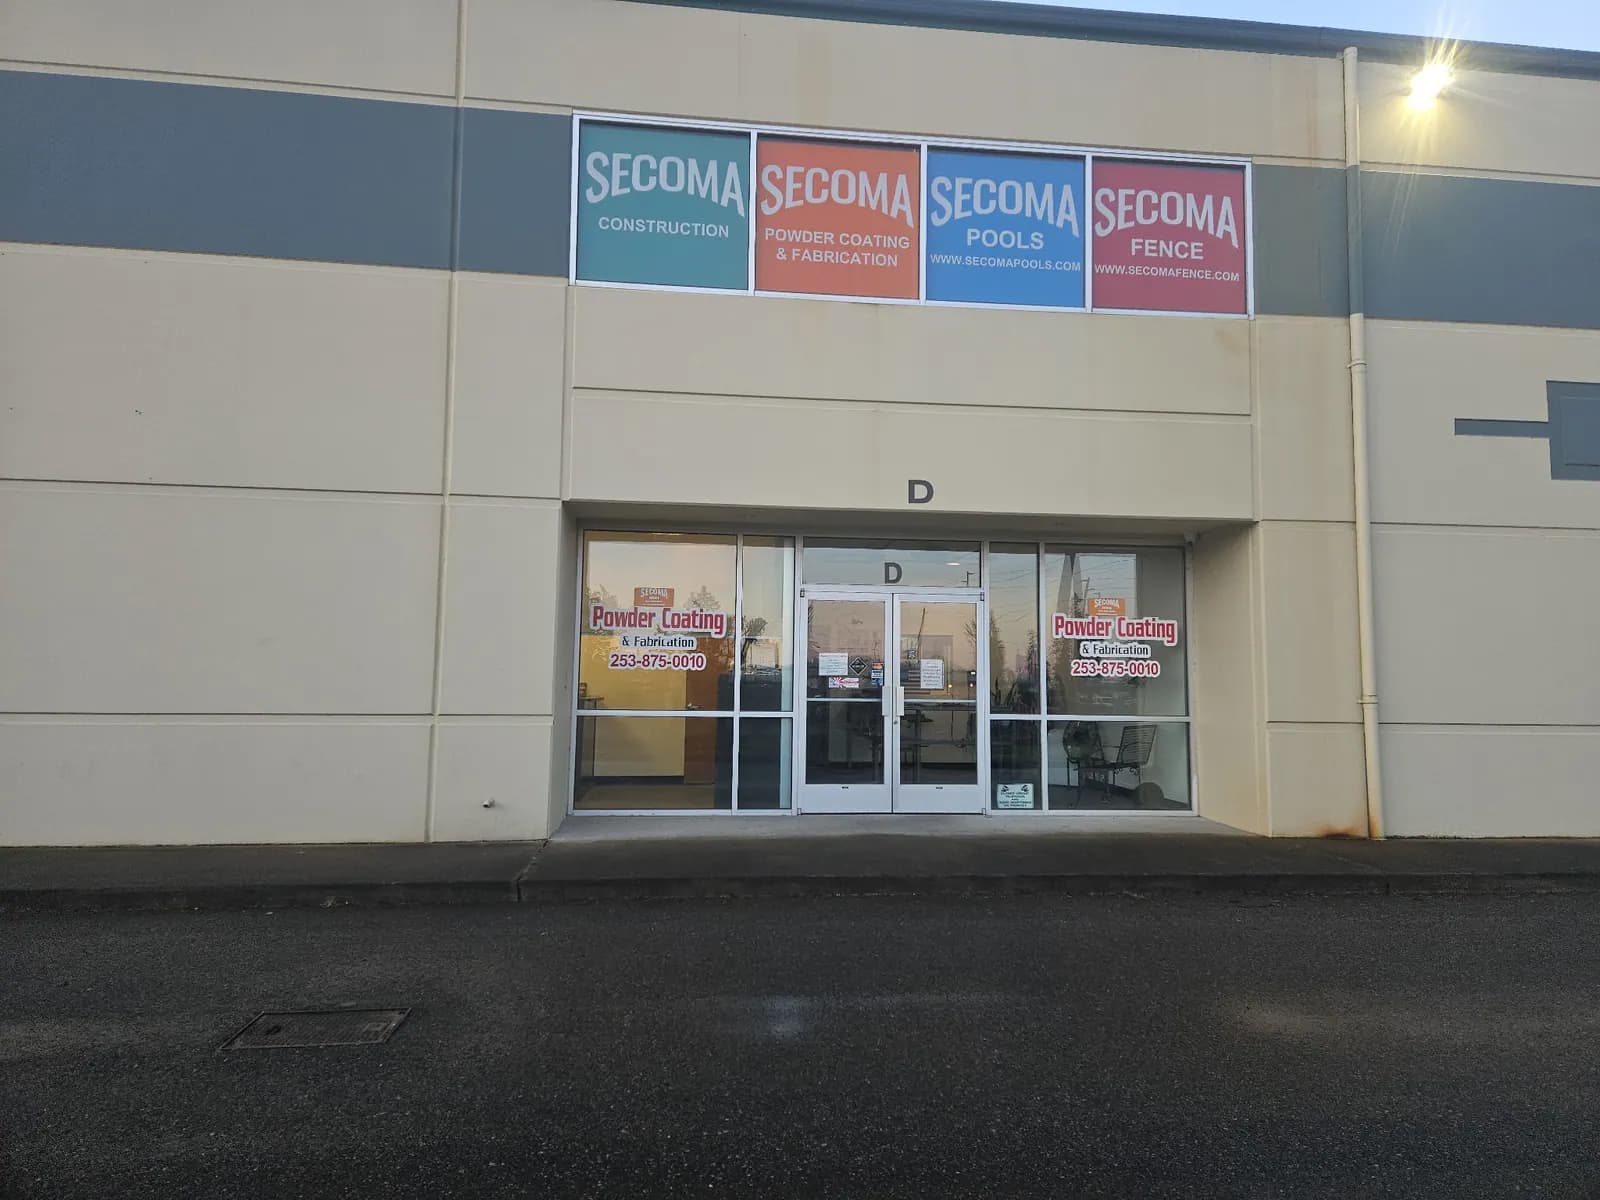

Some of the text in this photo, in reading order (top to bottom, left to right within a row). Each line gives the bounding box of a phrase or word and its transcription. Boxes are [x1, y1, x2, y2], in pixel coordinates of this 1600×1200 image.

[585, 151, 745, 218] SECOMA
[760, 164, 914, 229] SECOMA
[930, 175, 1080, 238] SECOMA
[598, 216, 729, 238] CONSTRUCTION
[1094, 187, 1239, 249] SECOMA
[765, 227, 910, 250] POWDER COATING
[966, 228, 1044, 250] POOLS
[1130, 238, 1204, 260] FENCE
[776, 247, 898, 267] & FABRICATION
[930, 253, 1081, 272] WWW.SECOMAPOOLS.COM
[1094, 263, 1240, 282] WWW.SECOMAFENCE.COM
[908, 479, 934, 504] D
[884, 562, 903, 584] D
[592, 605, 725, 635] Powder Coating
[1054, 615, 1176, 644] Powder Coating
[622, 635, 695, 648] & Fabrication
[1082, 643, 1149, 655] & Fabrication
[610, 653, 705, 669] 253-875-0010
[1072, 661, 1160, 676] 253-875-0010
